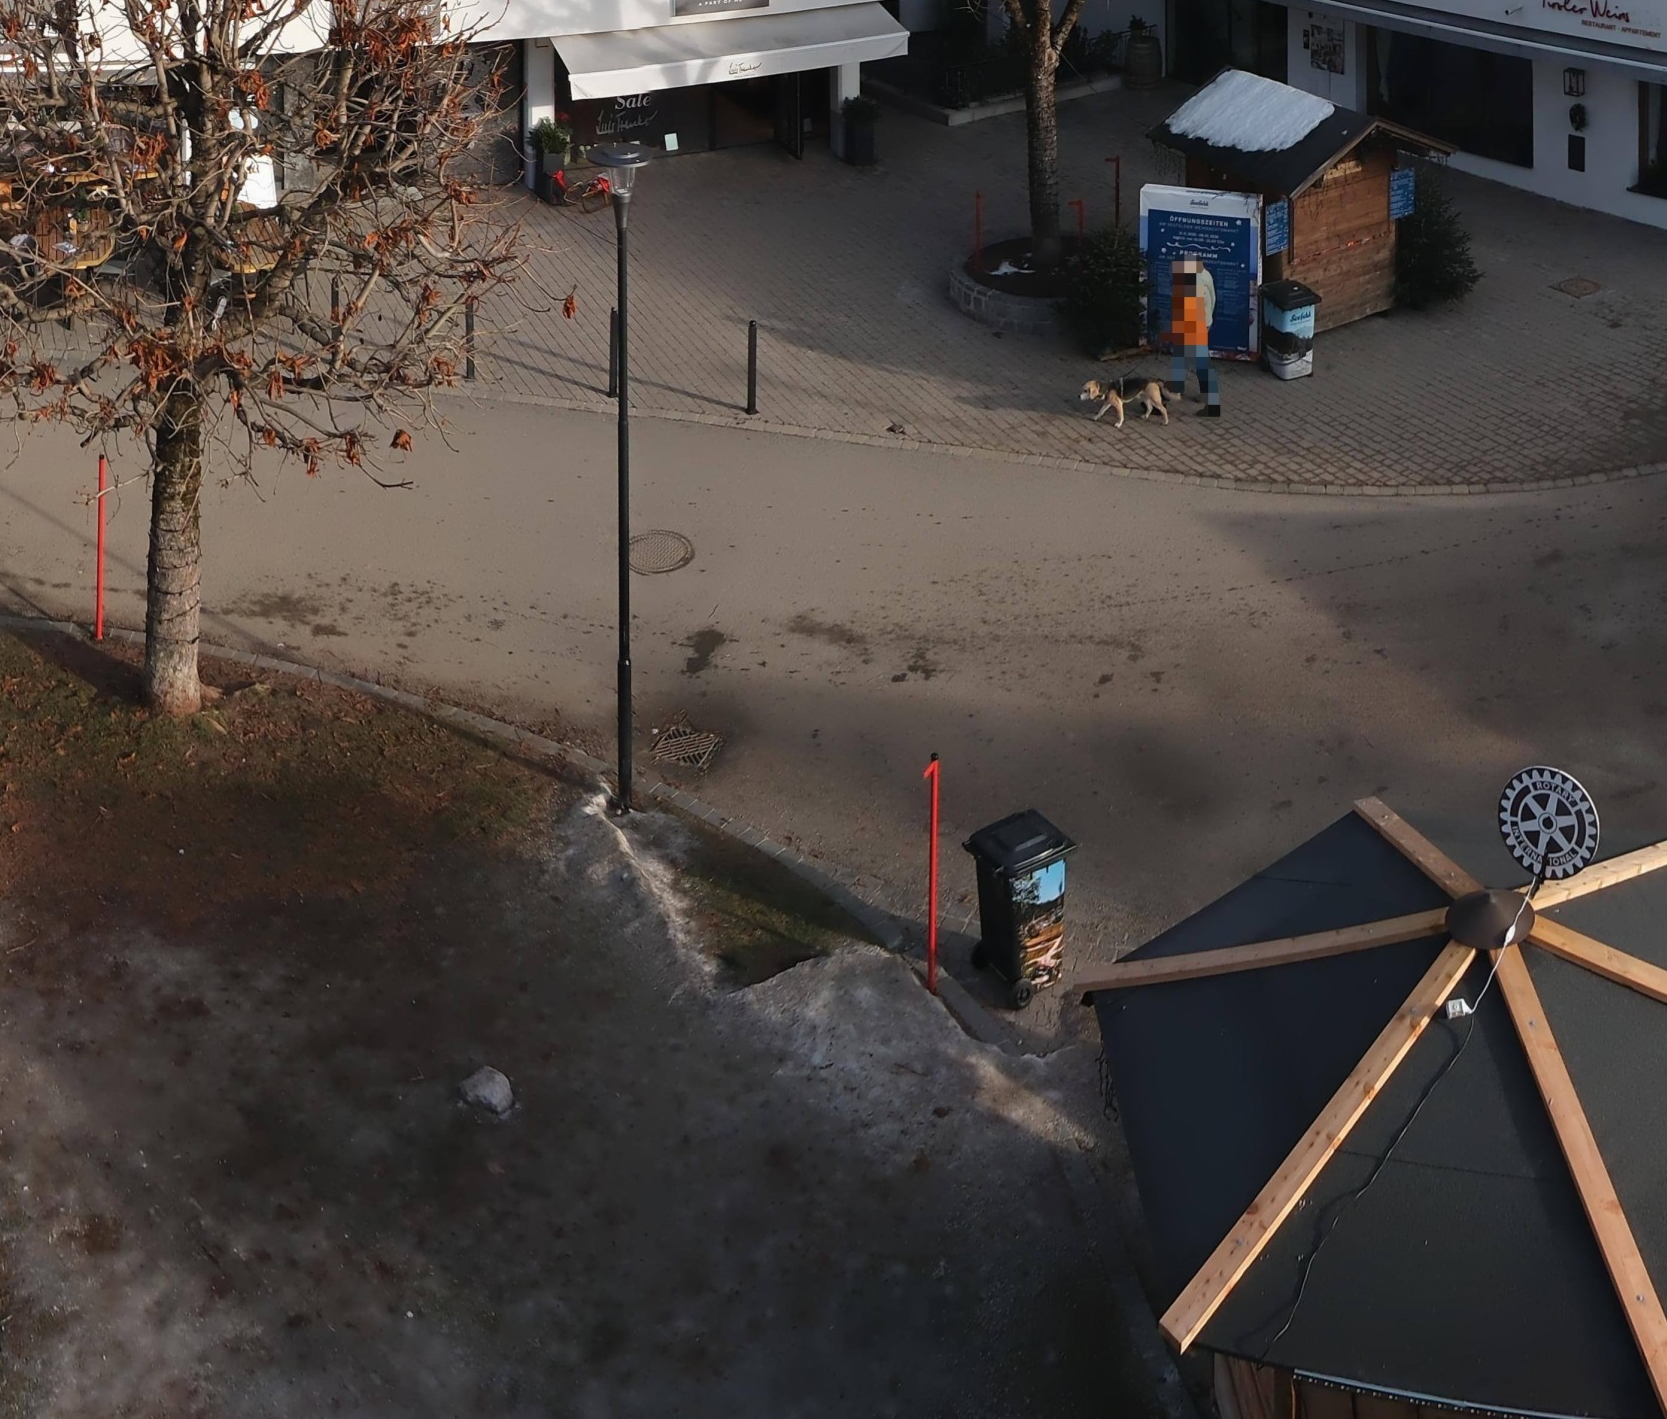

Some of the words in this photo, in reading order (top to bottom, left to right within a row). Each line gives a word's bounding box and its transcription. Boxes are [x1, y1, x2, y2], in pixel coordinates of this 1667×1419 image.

[1581, 19, 1617, 31] RESTAURANT
[1620, 26, 1662, 39] APPARTEMENT
[614, 93, 652, 110] Sale
[596, 110, 615, 136] Luis
[1169, 215, 1229, 227] ÖFFNUNGSZEITEN
[1290, 311, 1311, 323] Seefeld
[1536, 781, 1576, 803] ROTARY
[1511, 825, 1577, 867] INTERNAIONAL
